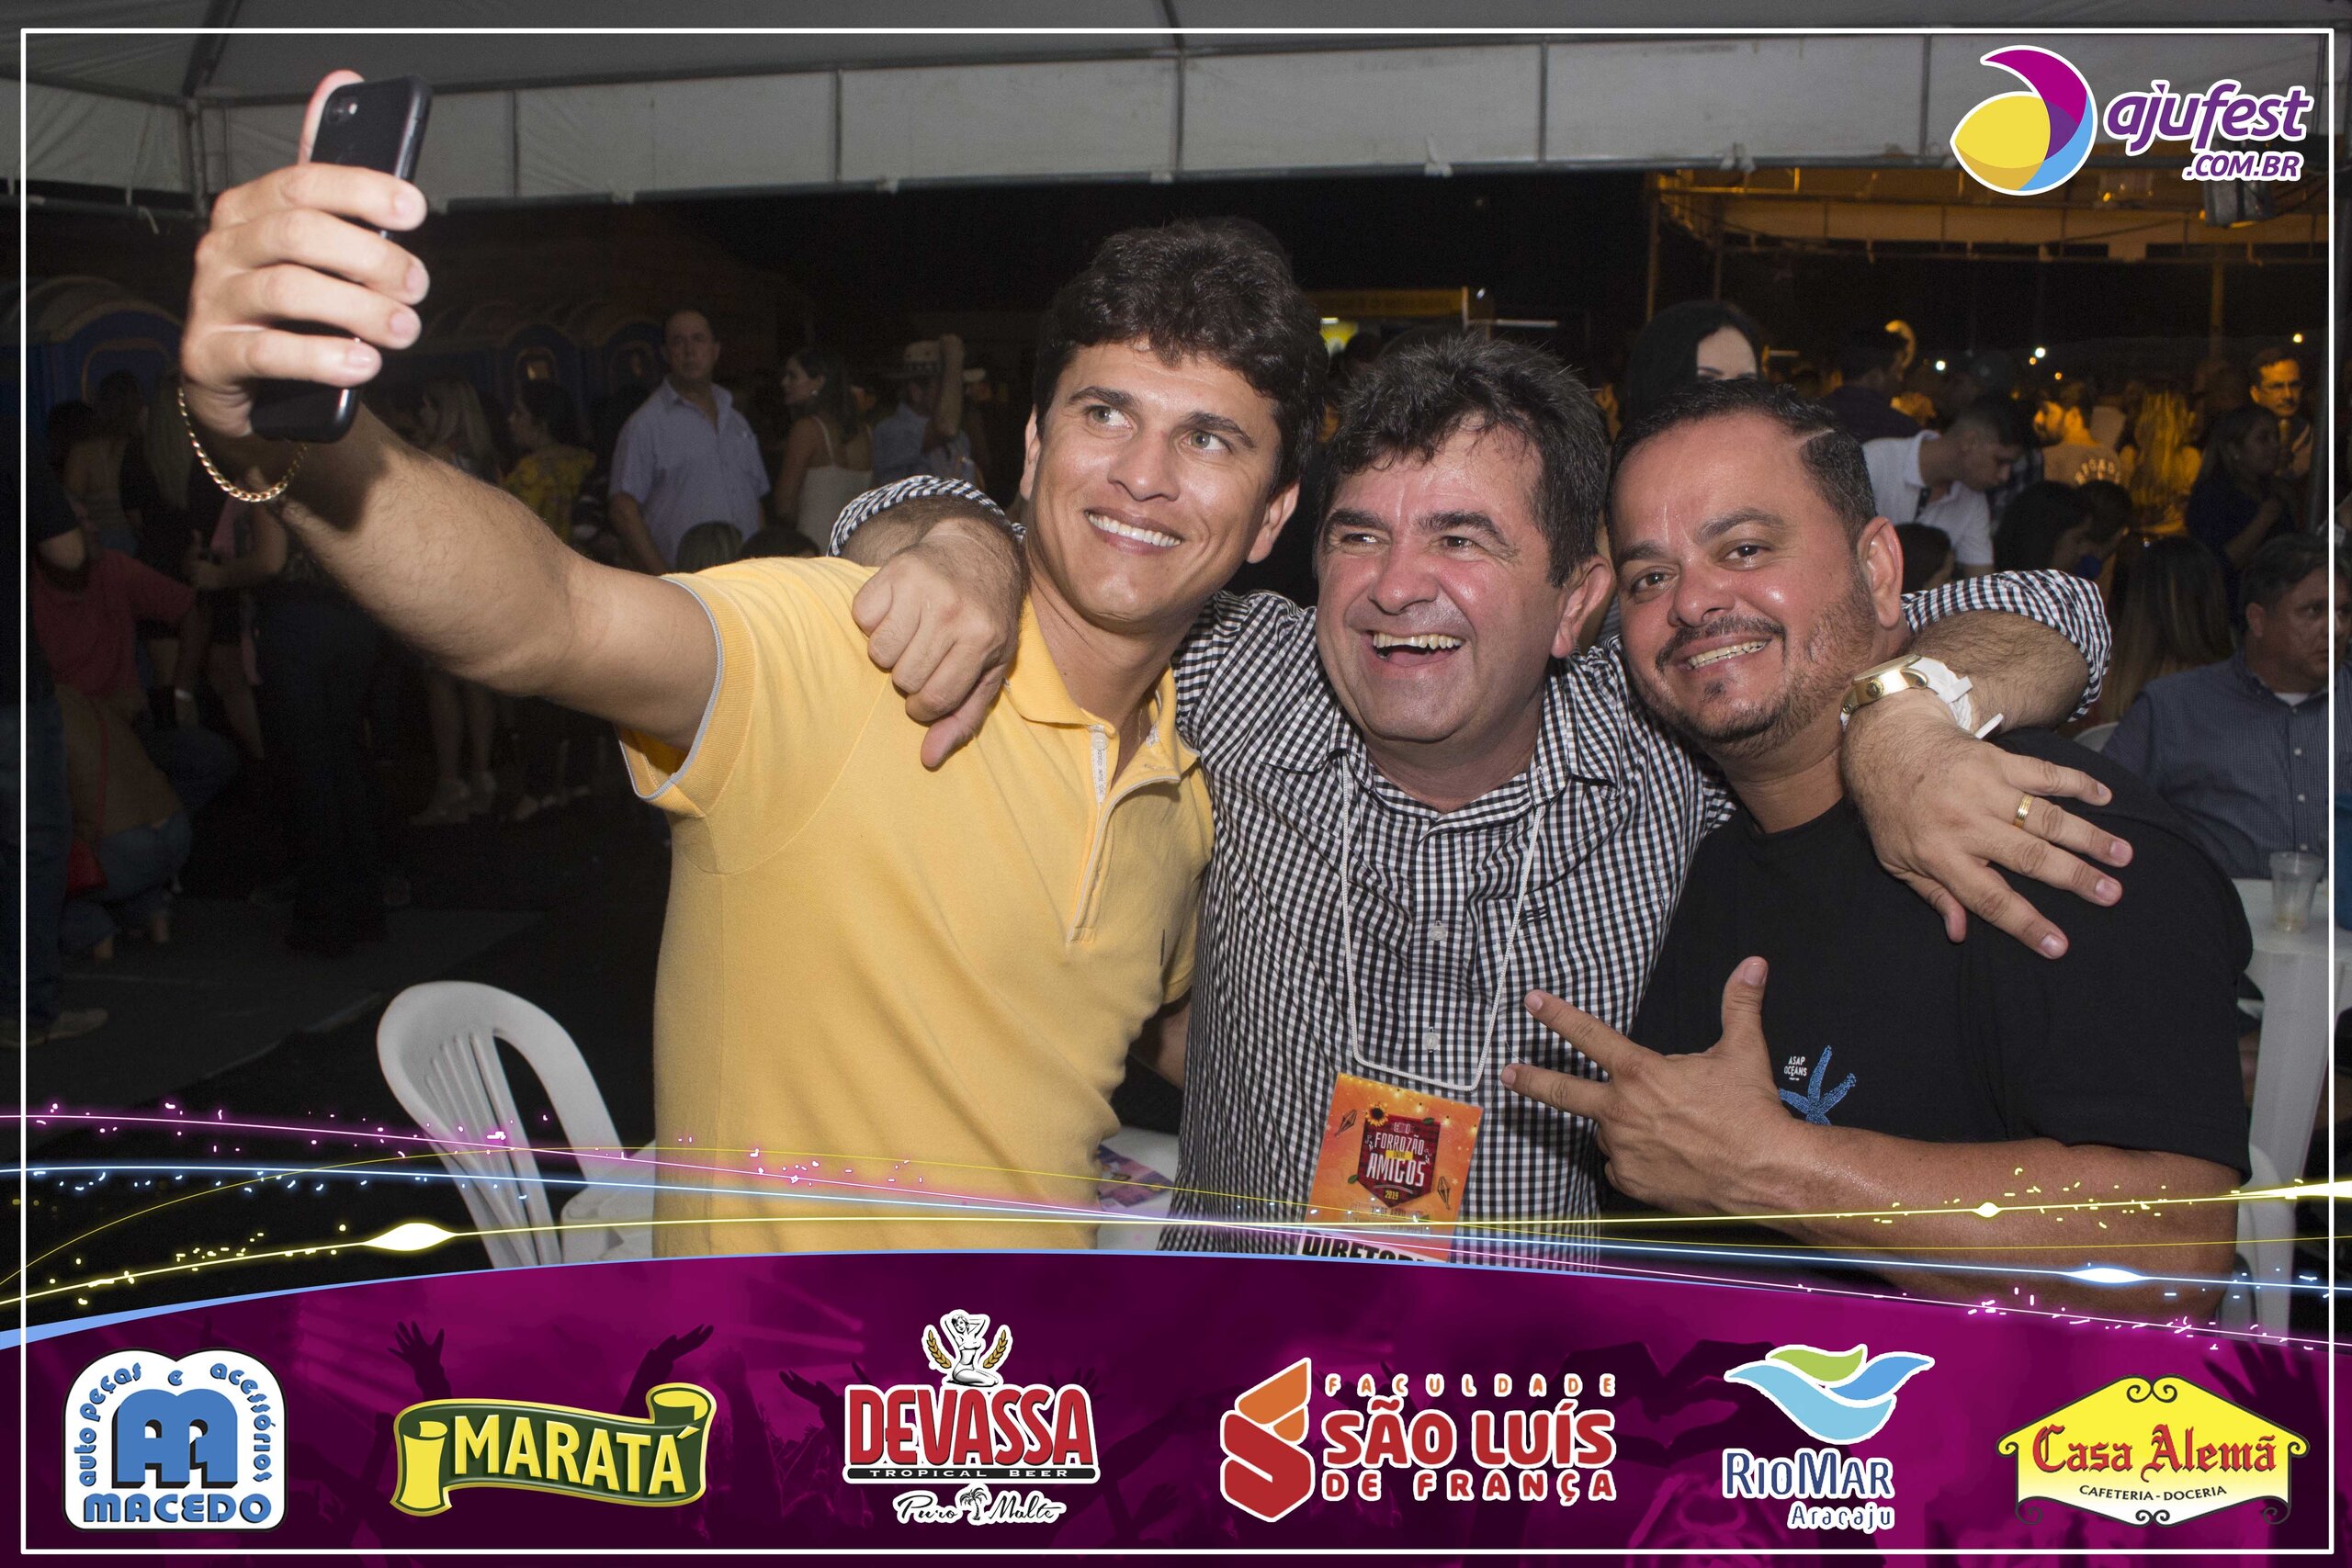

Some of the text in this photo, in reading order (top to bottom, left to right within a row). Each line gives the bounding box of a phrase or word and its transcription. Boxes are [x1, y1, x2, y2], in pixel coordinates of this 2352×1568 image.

[1788, 1055, 1805, 1066] ASAP
[1783, 1066, 1807, 1077] OCEANS
[1374, 1132, 1425, 1156] FORROZÃO
[1366, 1152, 1426, 1187] AMIGOS
